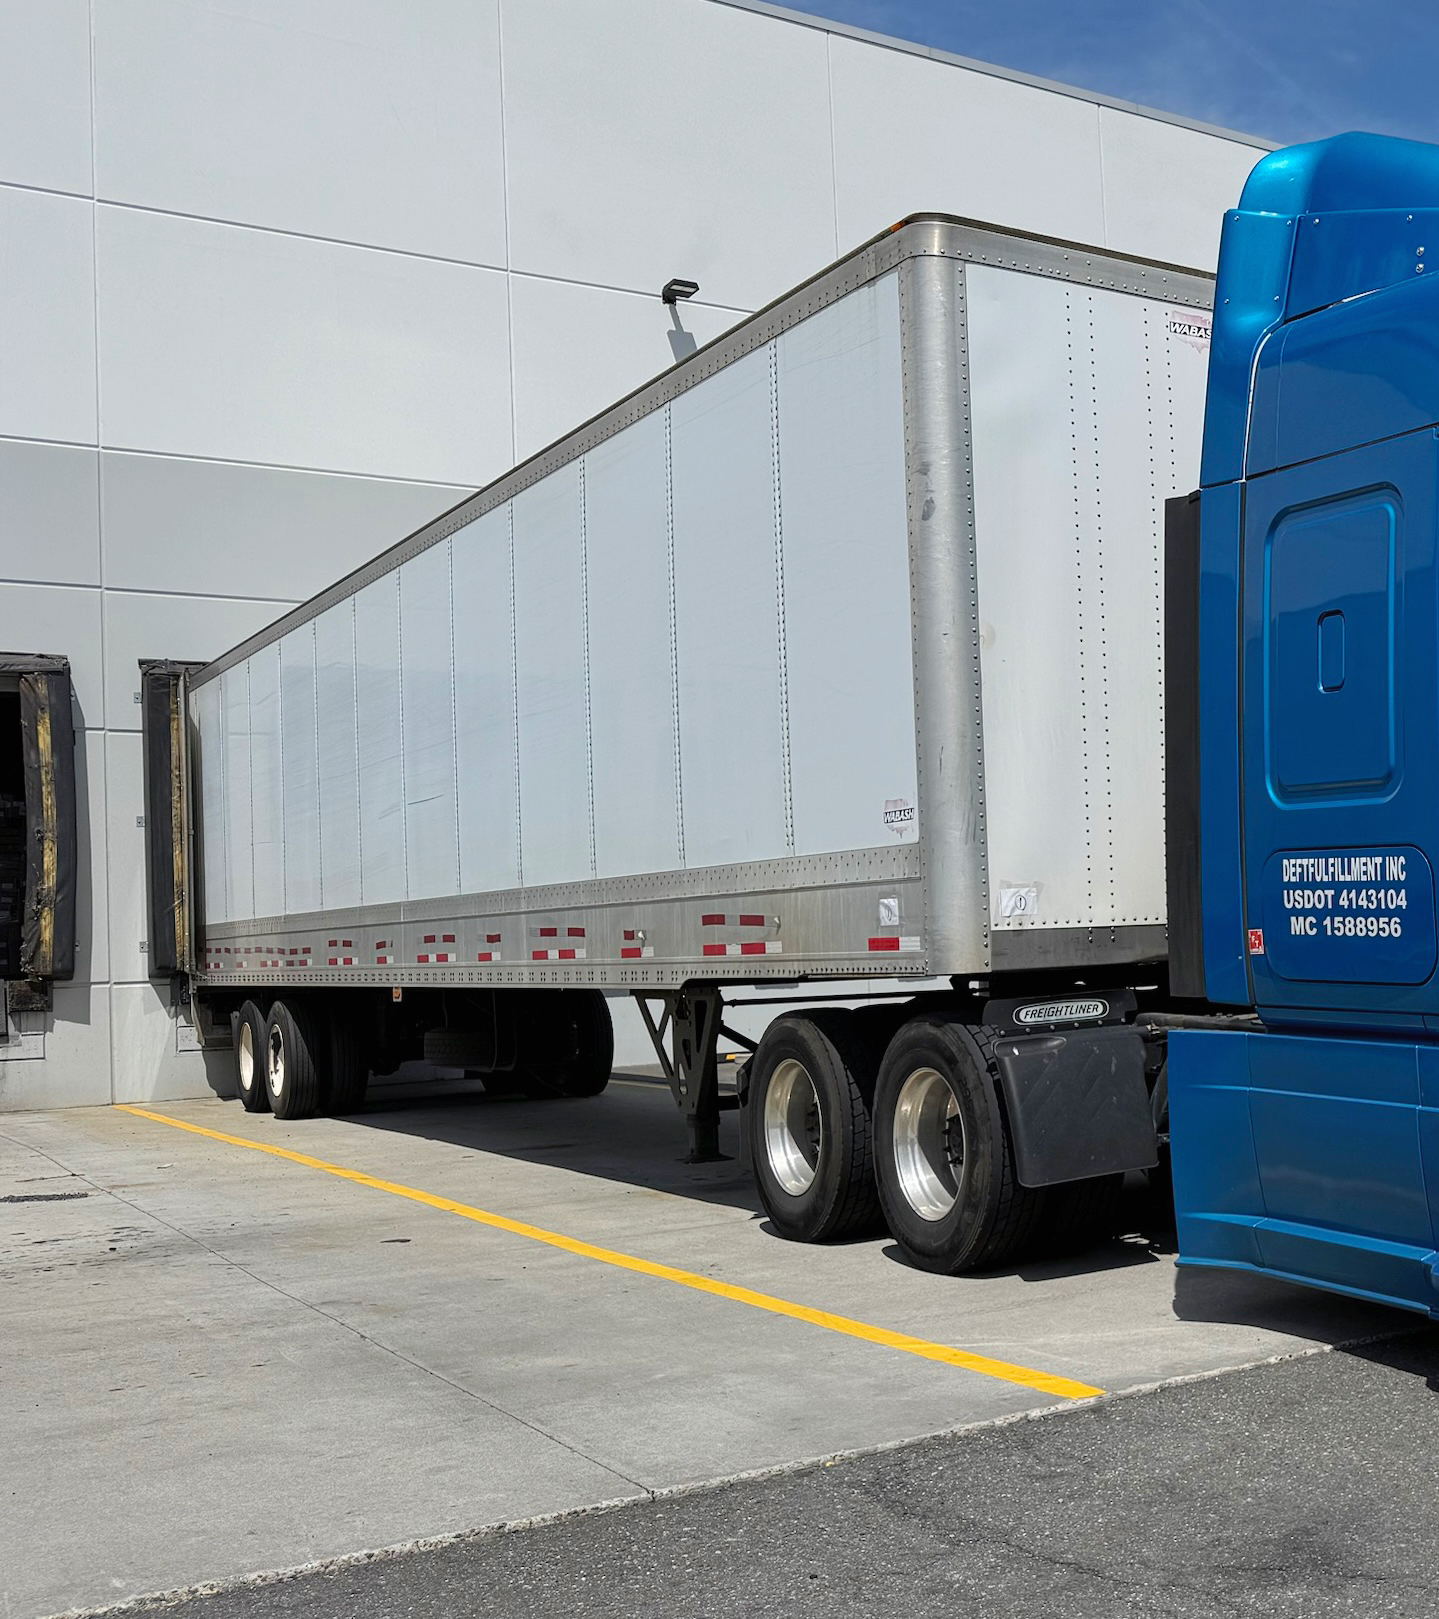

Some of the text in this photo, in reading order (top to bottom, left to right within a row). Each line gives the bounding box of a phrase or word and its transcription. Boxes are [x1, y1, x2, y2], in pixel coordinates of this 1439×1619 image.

[883, 807, 915, 824] WABASH
[1282, 855, 1406, 882] DEFTFULFILLMENT INC
[1283, 889, 1407, 910] USDOT 4143104
[1289, 915, 1402, 938] MC 1588956
[1023, 1003, 1100, 1020] FREIGHTLINER
